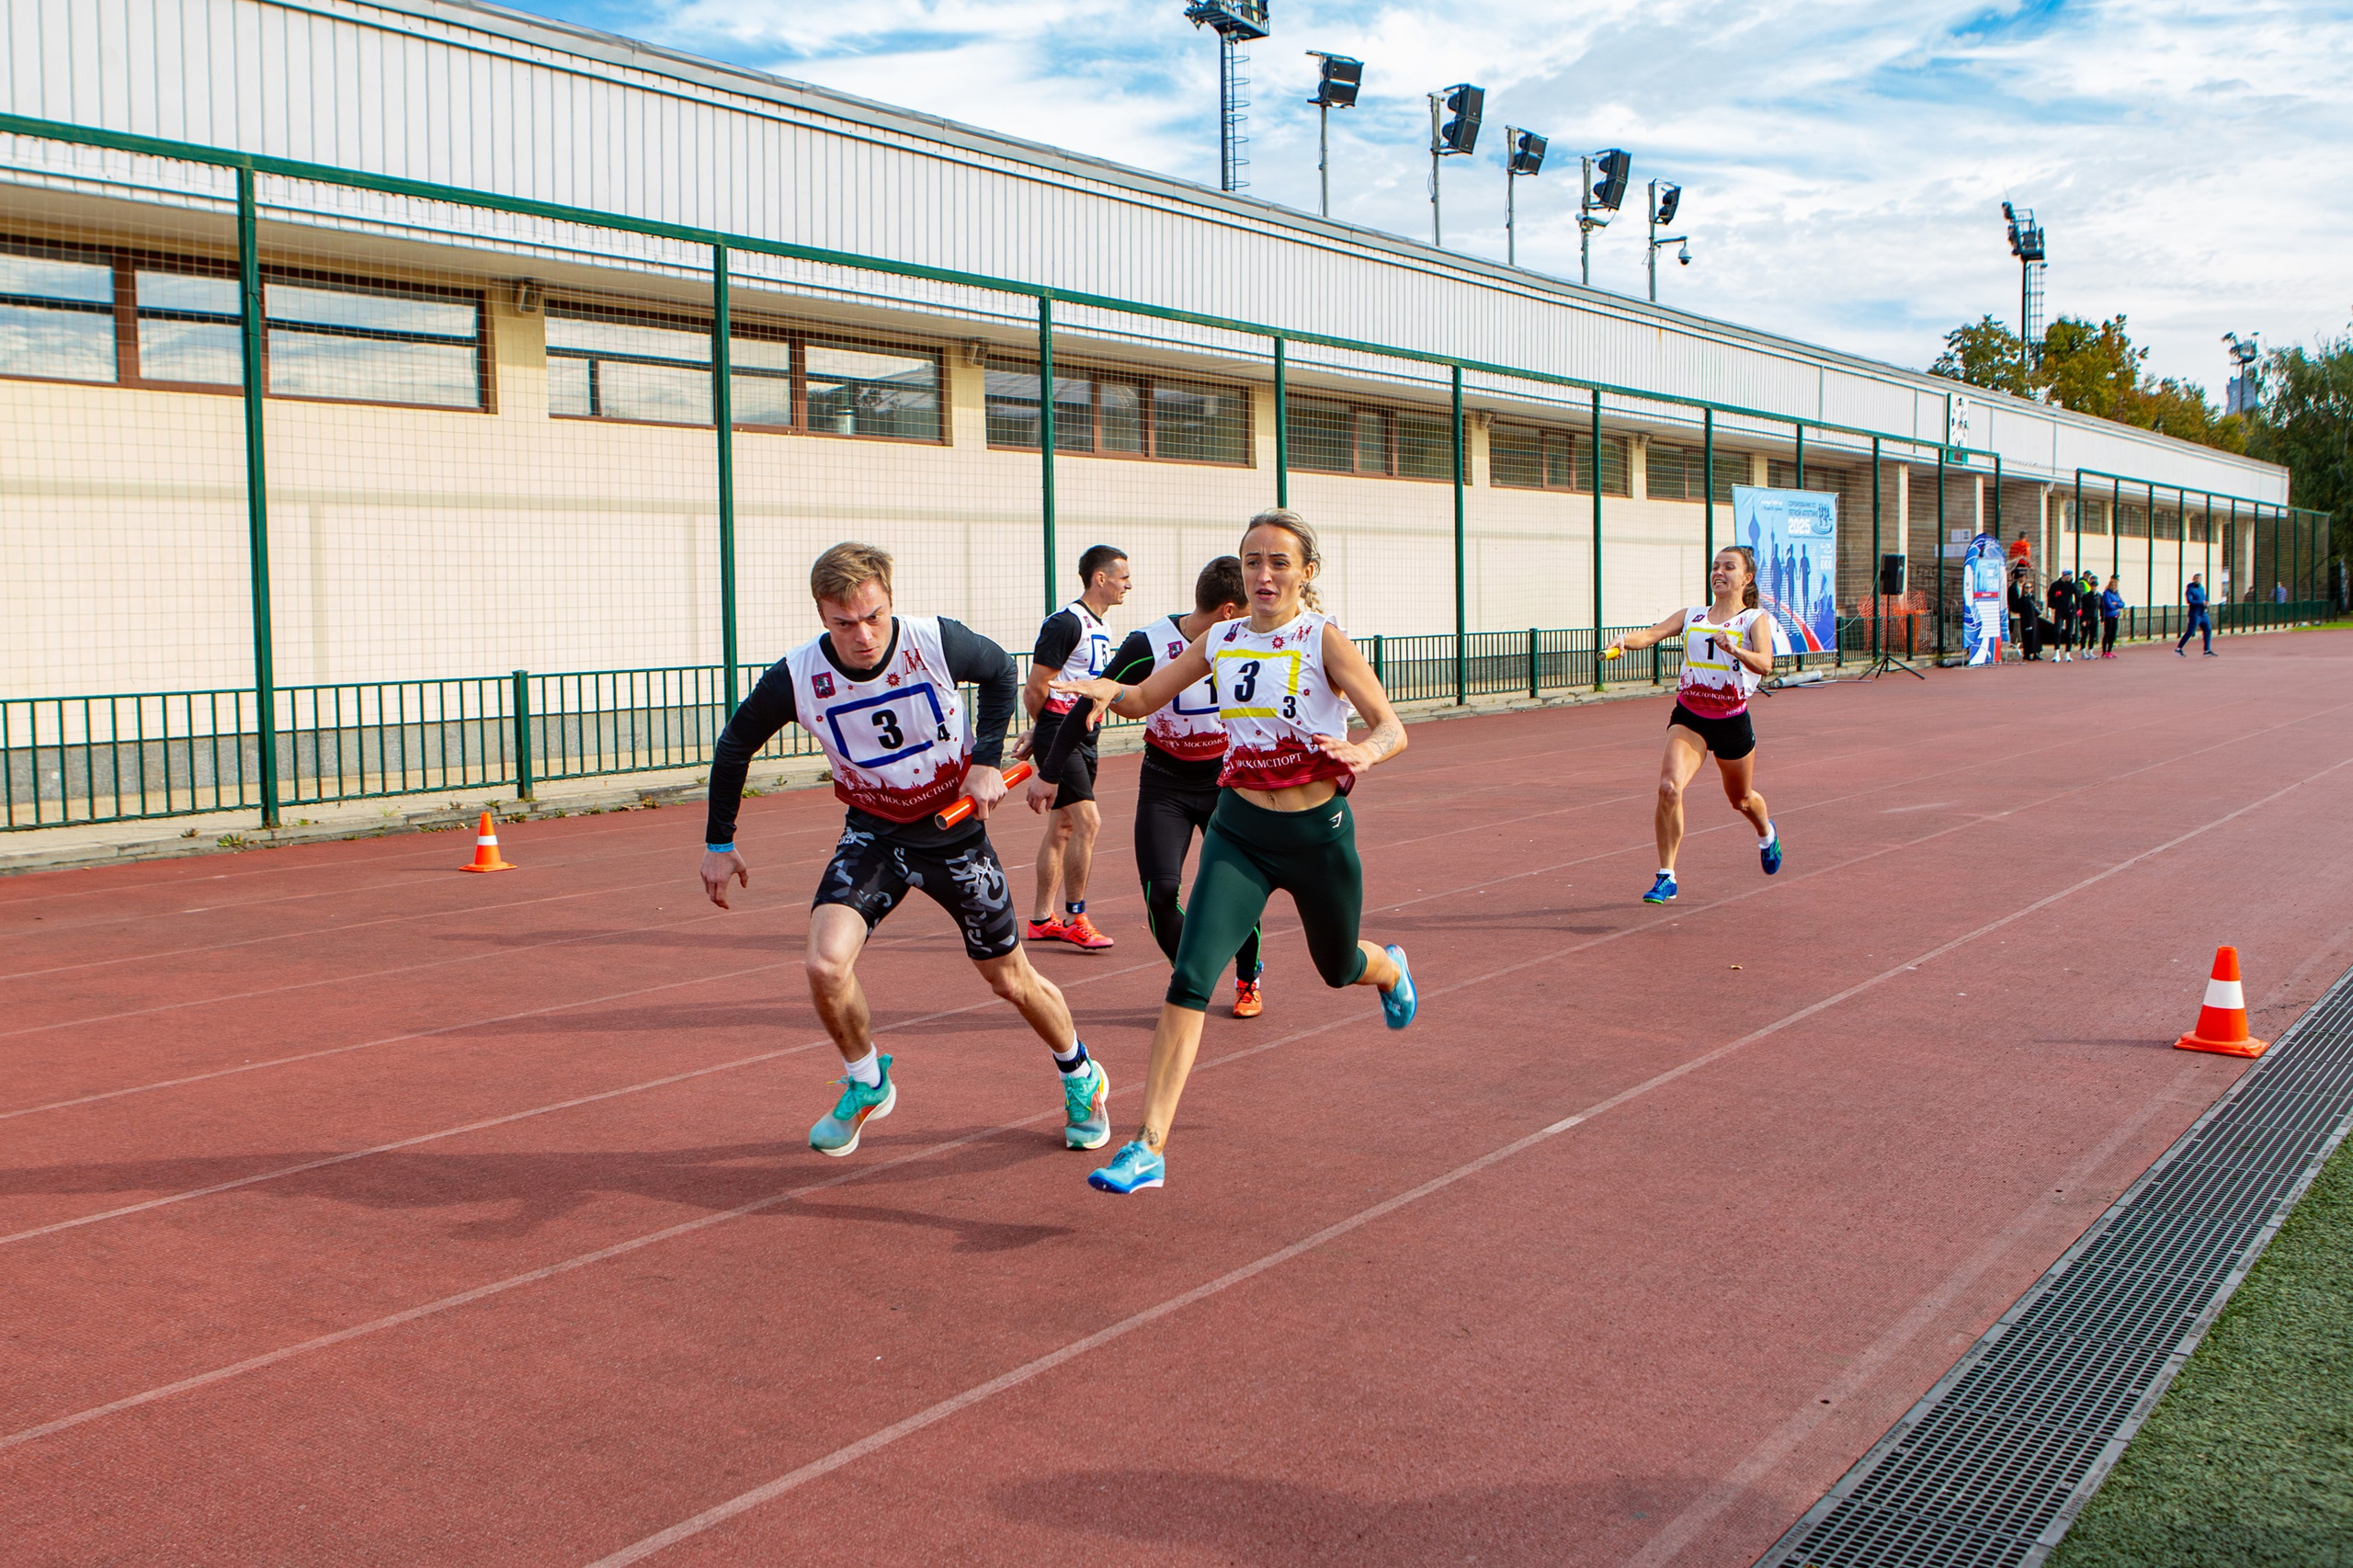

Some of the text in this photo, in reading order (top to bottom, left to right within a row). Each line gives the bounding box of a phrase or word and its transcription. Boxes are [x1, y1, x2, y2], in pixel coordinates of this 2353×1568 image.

[1788, 517, 1811, 534] 2025
[1705, 637, 1715, 660] 1
[1733, 658, 1740, 672] 3
[1204, 674, 1218, 705] 1
[1234, 660, 1260, 702] 3
[1282, 695, 1297, 719] 3
[871, 709, 904, 750] 3
[937, 722, 950, 743] 4
